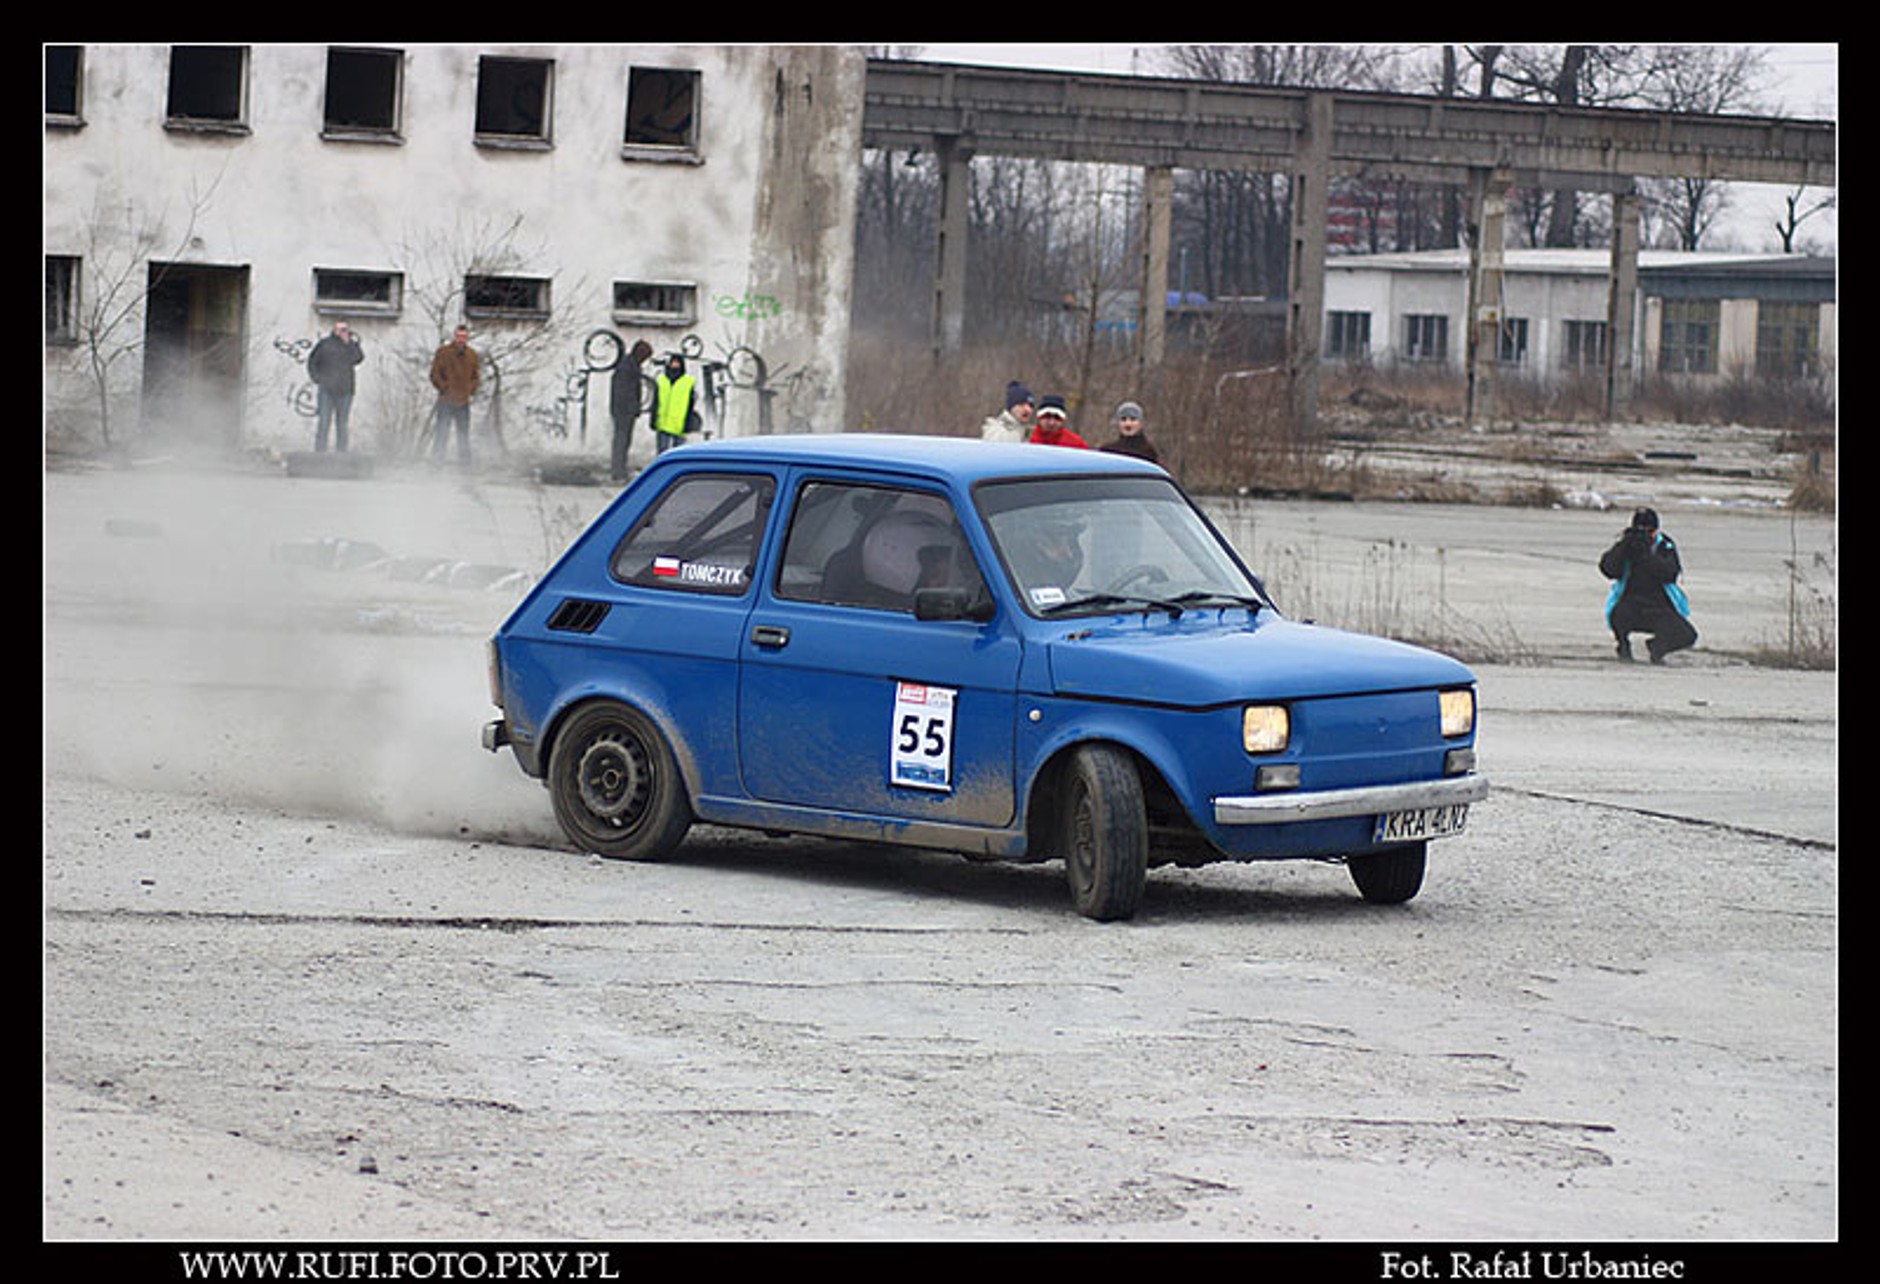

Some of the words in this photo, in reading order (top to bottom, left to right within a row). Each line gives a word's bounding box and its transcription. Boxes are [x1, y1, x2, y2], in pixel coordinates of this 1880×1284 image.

[681, 562, 742, 585] TOMCZYK
[899, 715, 945, 758] 55
[1386, 810, 1425, 838] KRA
